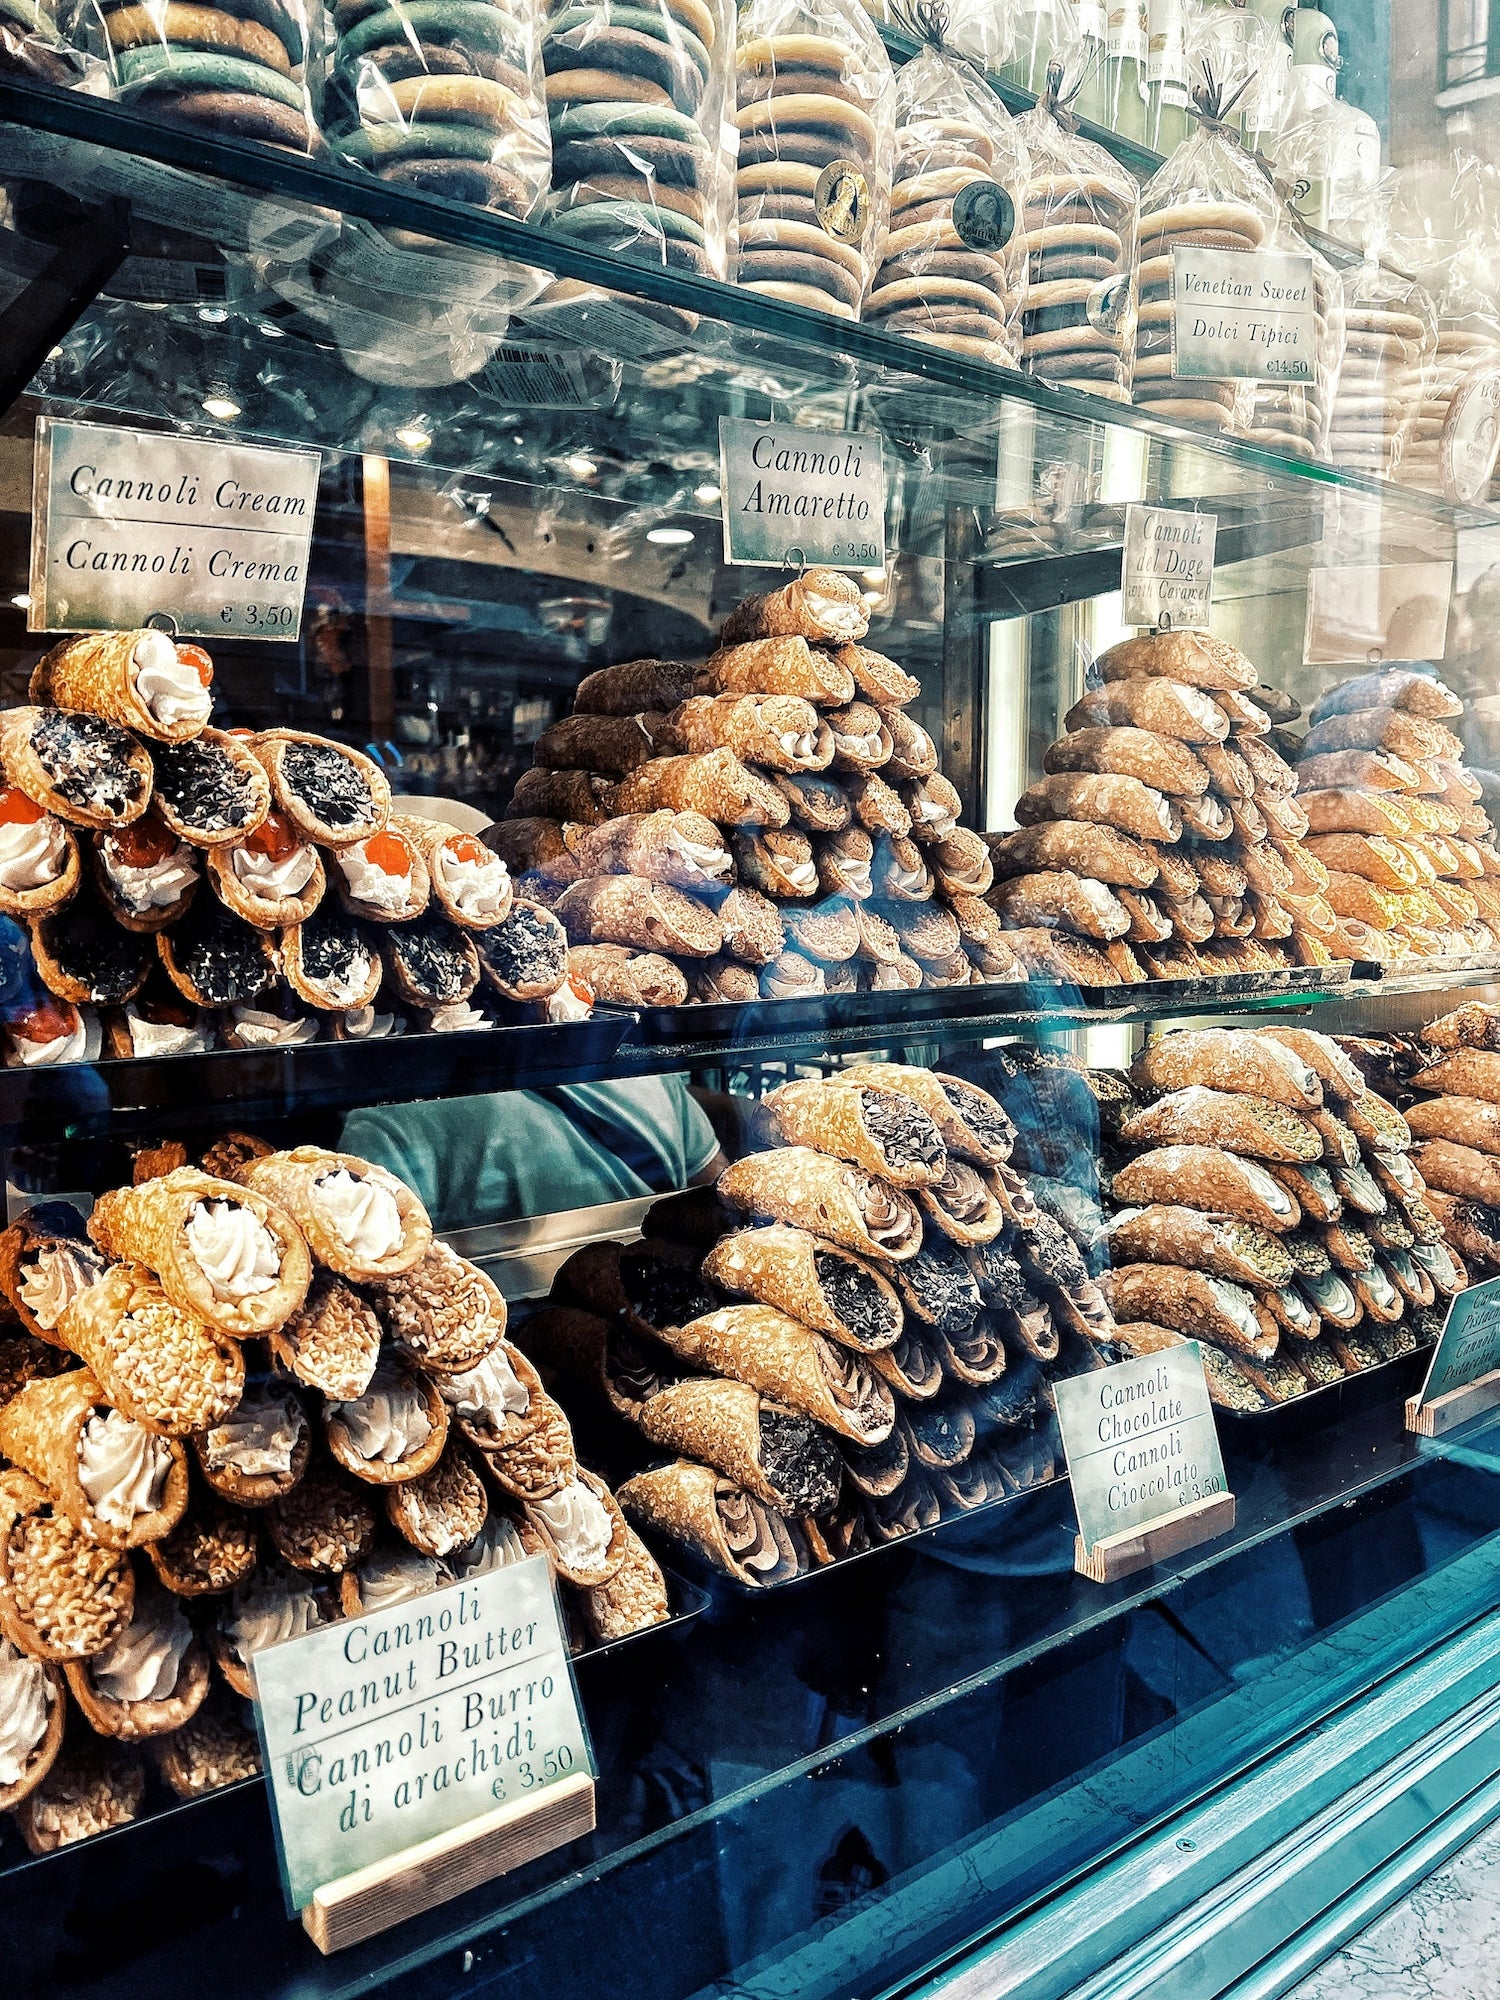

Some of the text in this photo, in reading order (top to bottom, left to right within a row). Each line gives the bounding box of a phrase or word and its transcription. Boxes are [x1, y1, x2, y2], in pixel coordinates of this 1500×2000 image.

[1184, 272, 1307, 301] Venetian Sweet
[1192, 318, 1299, 348] Dolci Tipici
[1266, 359, 1308, 375] €14,50
[752, 435, 863, 478] Cannoli
[69, 465, 306, 516] Cannoli Cream
[741, 479, 870, 521] Amaretto
[846, 542, 877, 559] 3,50
[1143, 515, 1205, 545] Cannoli
[65, 540, 299, 583] Cannoli Crema
[1136, 548, 1203, 581] del Doge
[1127, 579, 1210, 601] with Caramel
[220, 605, 293, 628] € 3,50
[1455, 1325, 1497, 1359] Cannoli
[1100, 1366, 1170, 1410] Cannoli
[1098, 1400, 1183, 1443] Chocolate
[1113, 1430, 1183, 1477] Cannoli
[1107, 1462, 1198, 1512] Cioccolato
[343, 1587, 482, 1664] Cannoli
[291, 1620, 538, 1736] Peanut Butter
[297, 1706, 444, 1797] Cannoli
[460, 1675, 555, 1733] Burro
[339, 1716, 537, 1833] di arachidi
[491, 1744, 574, 1801] € 3,50
